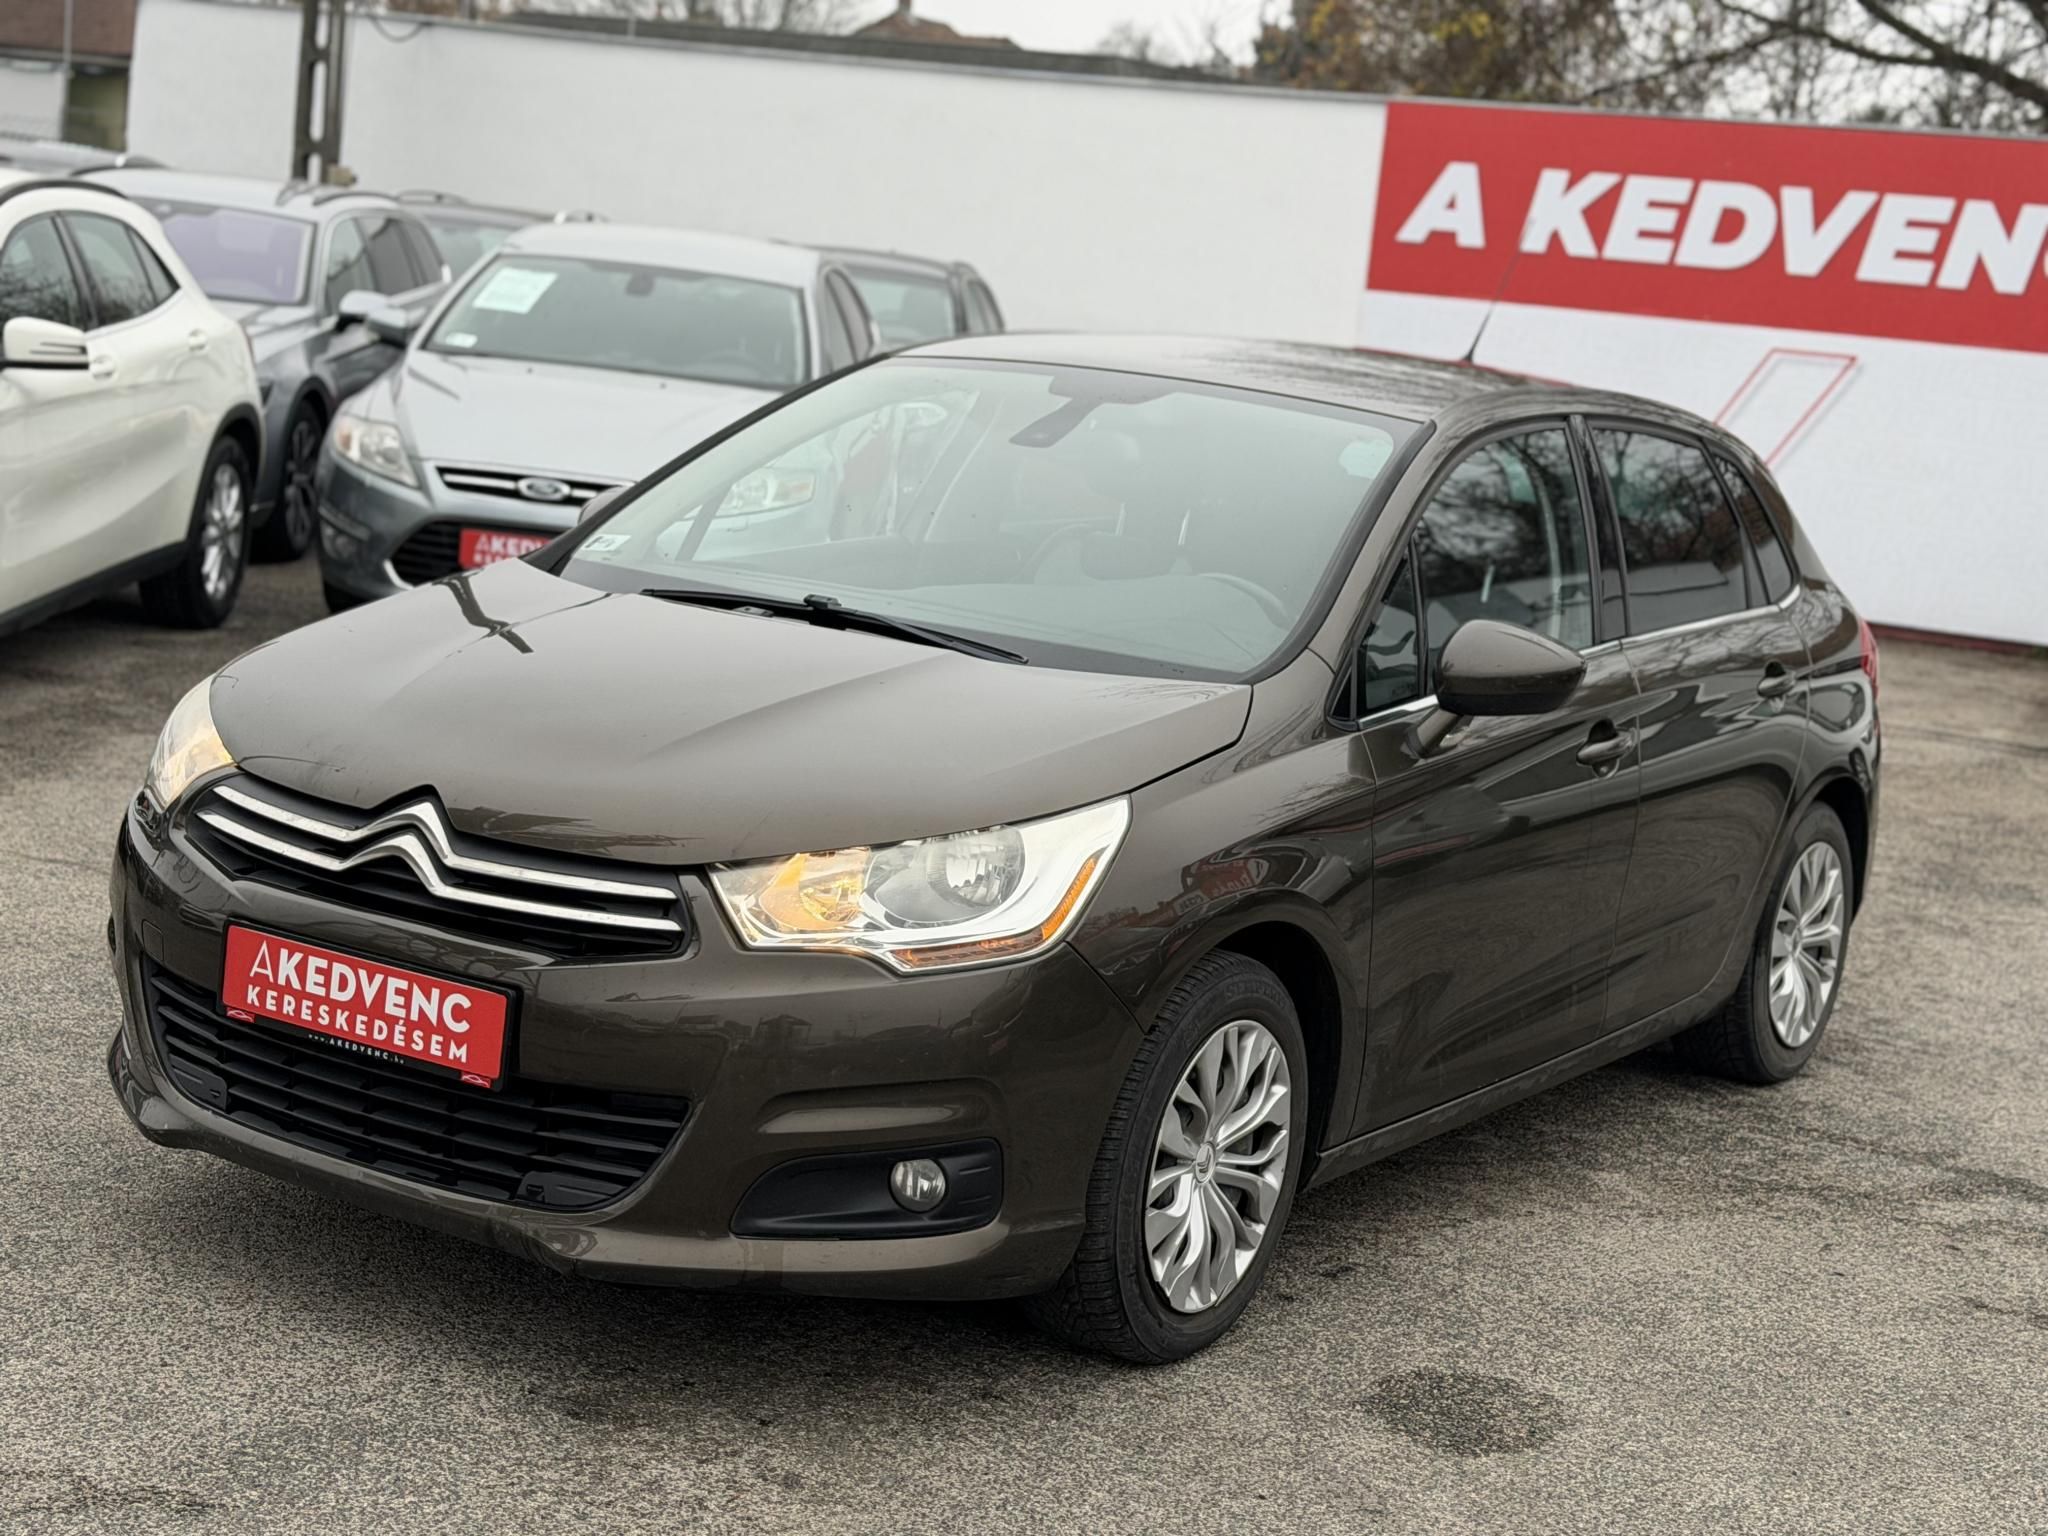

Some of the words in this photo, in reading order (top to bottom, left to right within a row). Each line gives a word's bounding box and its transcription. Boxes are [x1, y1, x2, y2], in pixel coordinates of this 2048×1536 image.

[1395, 161, 1486, 250] A
[1519, 167, 2048, 295] KEDVEN
[247, 984, 467, 1063] KERESKEDÉSEM
